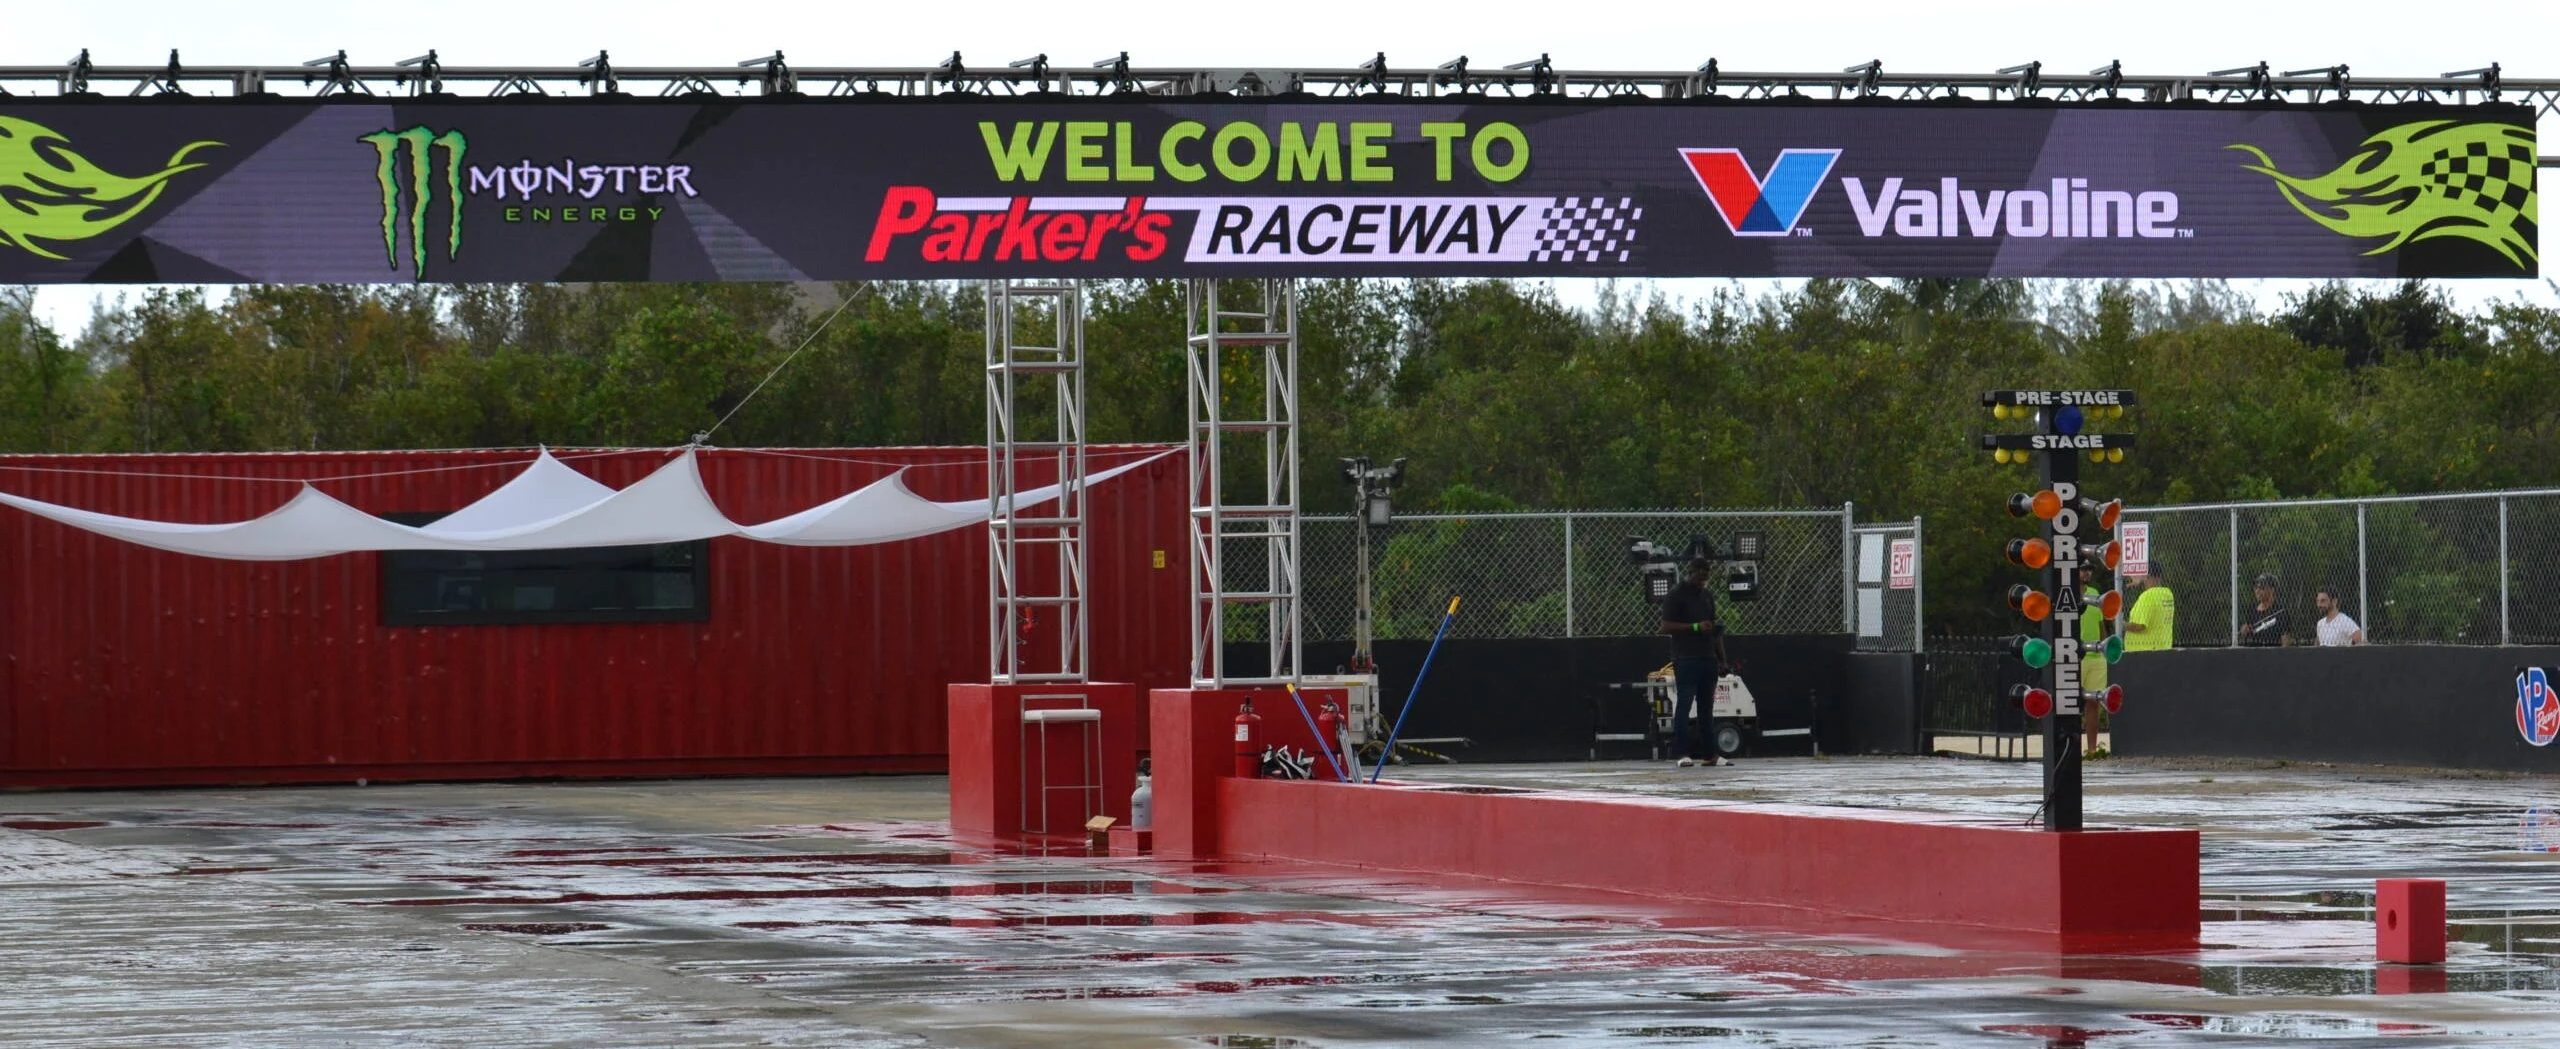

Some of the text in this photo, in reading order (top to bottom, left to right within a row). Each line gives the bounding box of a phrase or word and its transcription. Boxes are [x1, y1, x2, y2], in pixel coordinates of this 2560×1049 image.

[978, 121, 1530, 182] WELCOME TO
[505, 207, 664, 222] ENERGY
[1841, 177, 2179, 238] Valvoline
[864, 186, 1529, 262] Parker's RACEWAY
[2015, 391, 2120, 405] PRE-STAGE
[2031, 434, 2105, 449] STAGE
[2125, 538, 2145, 560] EXIT
[1893, 553, 1912, 574] EXIT
[2516, 666, 2547, 744] VP
